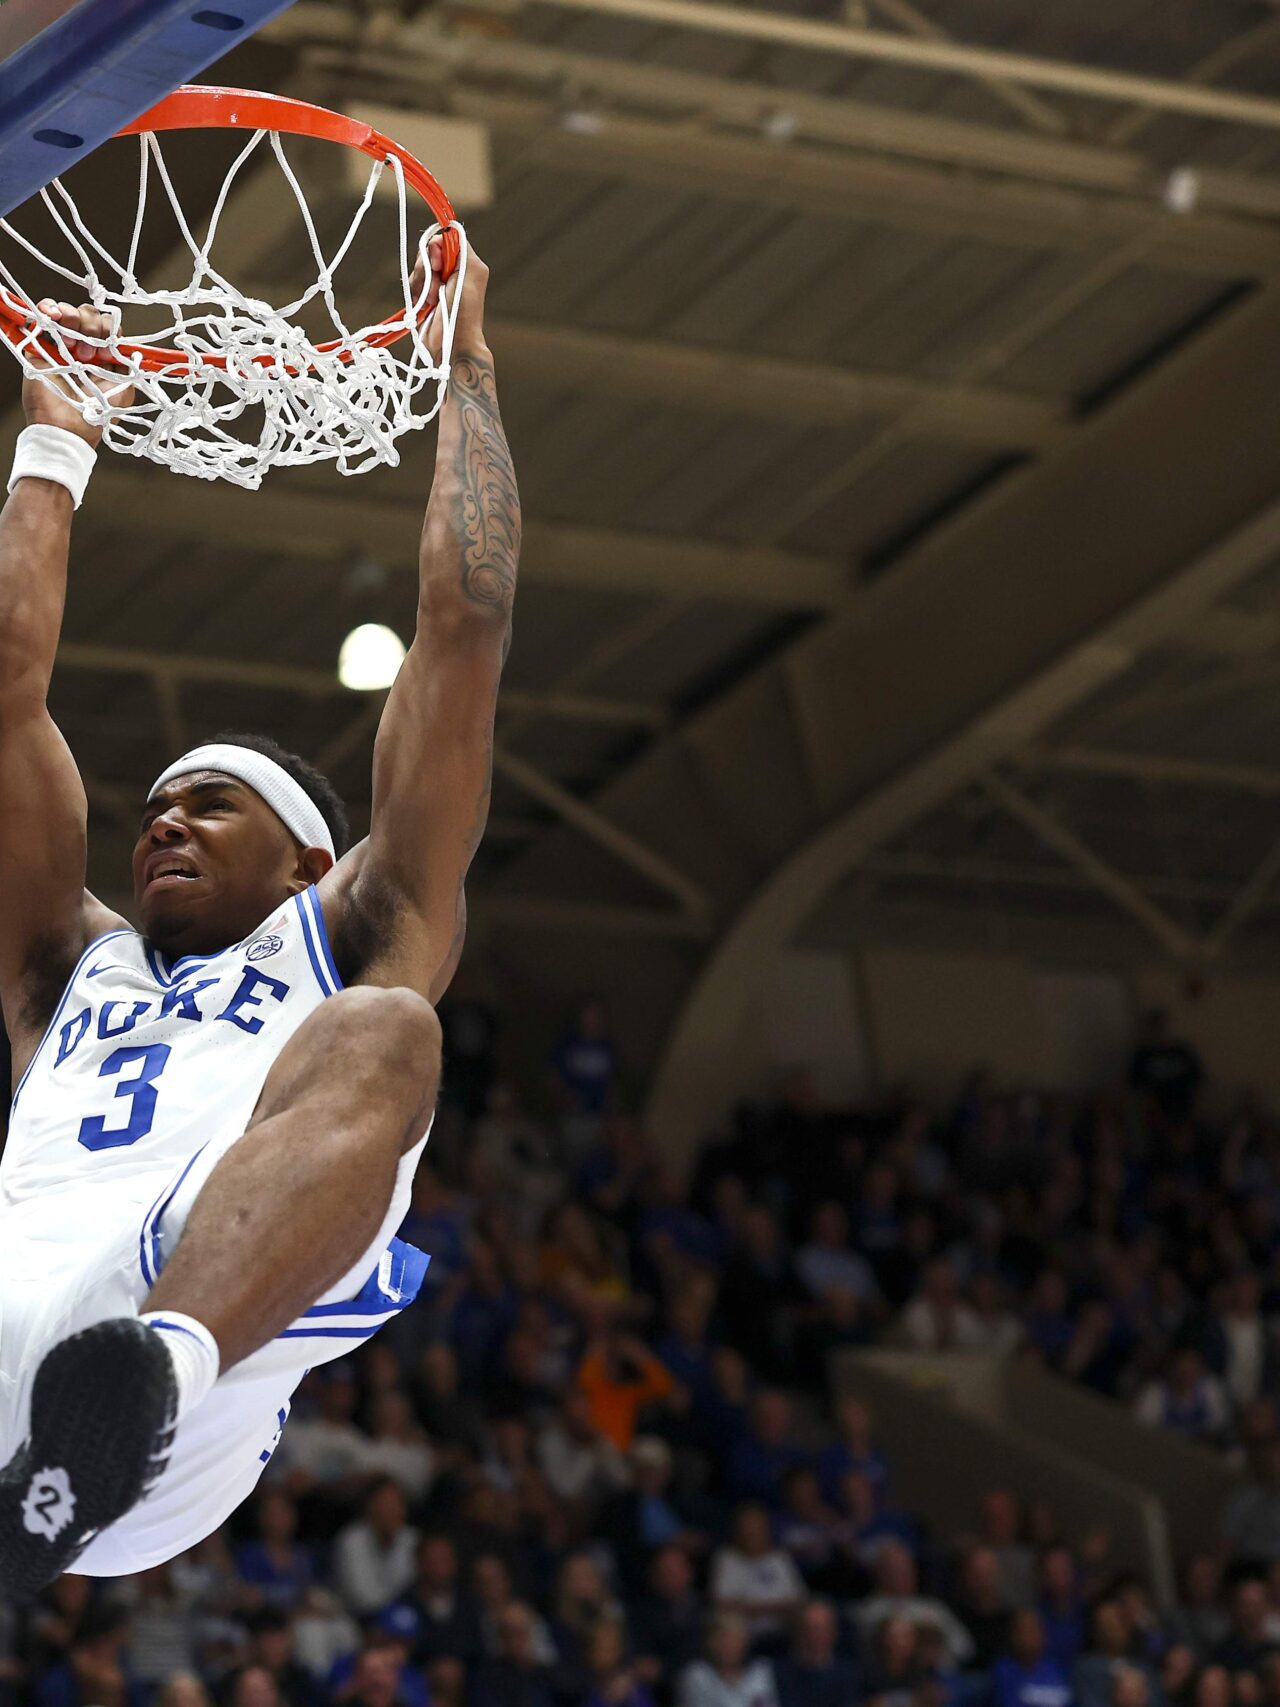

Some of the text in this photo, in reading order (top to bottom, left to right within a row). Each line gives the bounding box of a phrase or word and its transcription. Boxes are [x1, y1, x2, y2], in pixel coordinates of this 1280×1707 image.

[53, 965, 291, 1070] DUKE
[78, 1043, 172, 1151] 3
[34, 1485, 61, 1525] 2
